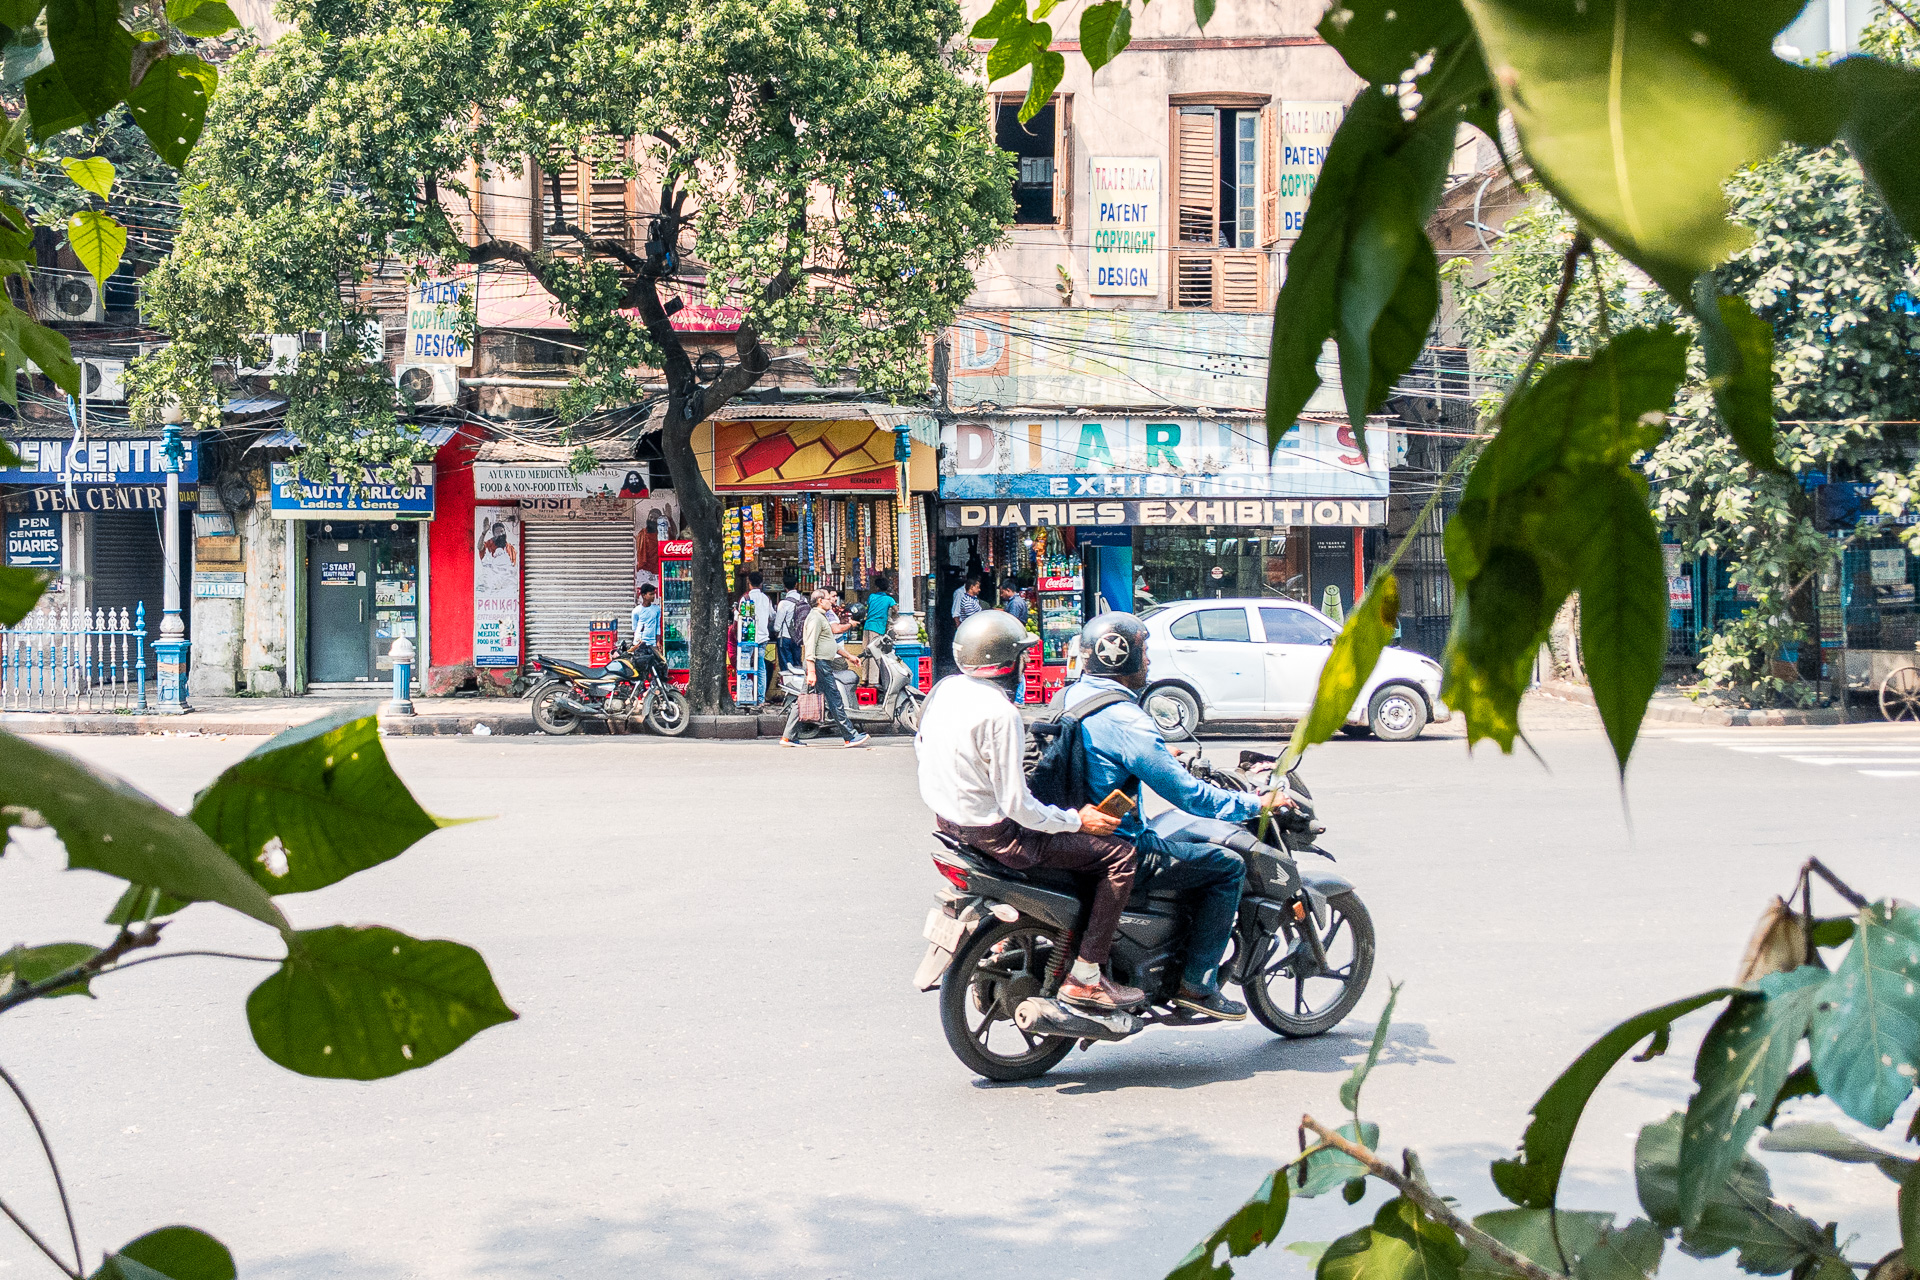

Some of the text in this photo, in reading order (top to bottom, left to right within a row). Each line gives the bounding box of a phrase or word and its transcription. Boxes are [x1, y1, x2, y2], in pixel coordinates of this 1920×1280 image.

[1281, 174, 1319, 197] COPYR
[1100, 203, 1148, 221] PATENT
[1095, 230, 1155, 253] COPYRIGHT
[1098, 267, 1148, 286] DESIGN
[412, 309, 457, 331] COPYRIG
[671, 312, 742, 328] roperty Righ
[415, 333, 465, 357] DESIGN
[57, 473, 117, 482] DARIES
[488, 470, 526, 479] AYURVED
[480, 482, 584, 492] FOOD & NON-FOOD ITEMS
[1050, 477, 1269, 496] EXHIBITION
[34, 486, 167, 511] PEN CENTR
[300, 500, 399, 509] Ladies & Gents
[960, 501, 1370, 527] DIARIES EXHIBITION
[19, 518, 50, 528] PEN
[9, 530, 55, 538] CENTRE
[9, 539, 59, 553] DIARIES
[664, 541, 692, 556] Coca-Co
[329, 563, 348, 571] STAR
[196, 583, 241, 597] DIARIES
[477, 599, 517, 612] PANKAJ
